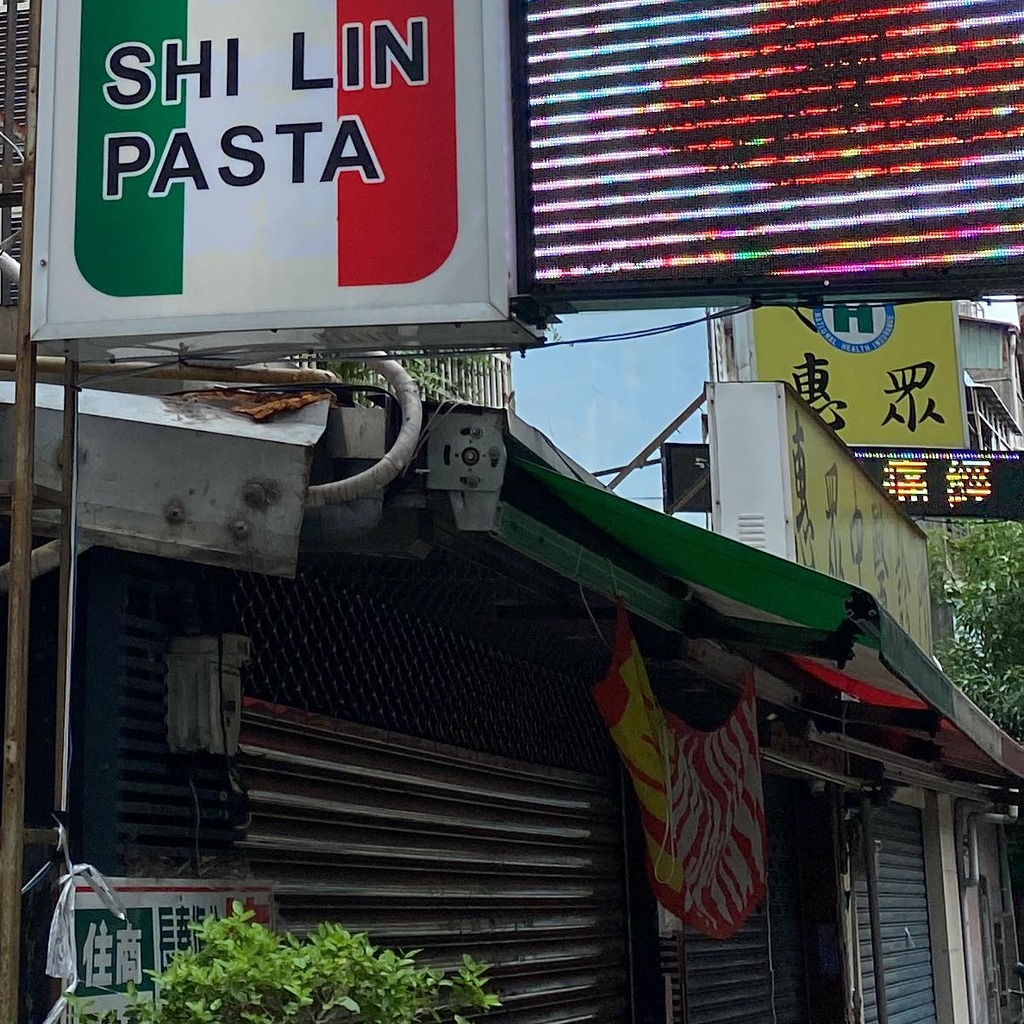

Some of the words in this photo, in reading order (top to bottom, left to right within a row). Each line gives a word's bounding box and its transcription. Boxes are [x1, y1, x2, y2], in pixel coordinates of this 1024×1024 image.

[105, 38, 240, 107] SHI
[291, 20, 427, 91] LIN
[106, 118, 381, 197] PASTA
[840, 343, 871, 353] HEALTH
[82, 919, 143, 987] 住商
